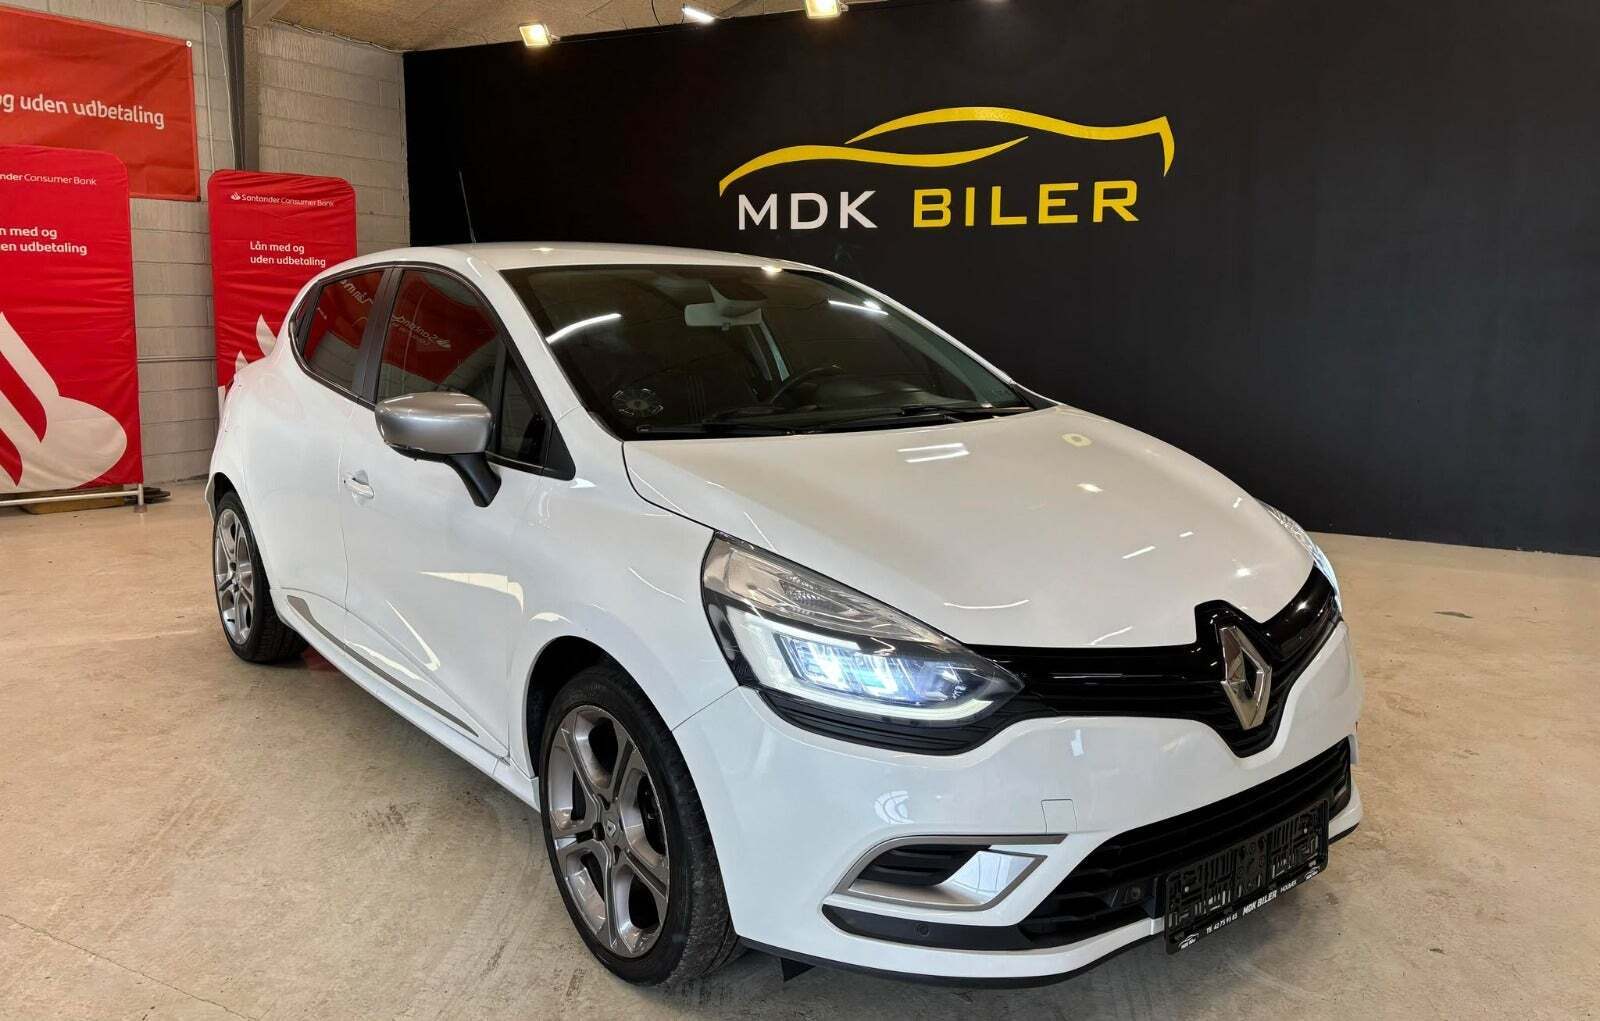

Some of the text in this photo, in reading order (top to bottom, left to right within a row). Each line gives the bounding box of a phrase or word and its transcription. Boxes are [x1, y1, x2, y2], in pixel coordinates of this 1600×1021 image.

[0, 93, 165, 130] g uden udbetaling
[24, 173, 72, 184] Consumer
[74, 177, 96, 185] Bank
[241, 194, 280, 203] Santander
[738, 180, 1140, 230] MDK BILER
[10, 226, 38, 237] med
[41, 229, 57, 240] og
[20, 241, 88, 256] udbetaling
[250, 240, 304, 254] Lån med og
[250, 254, 326, 269] uden udbetaling
[1256, 889, 1278, 908] BILER
